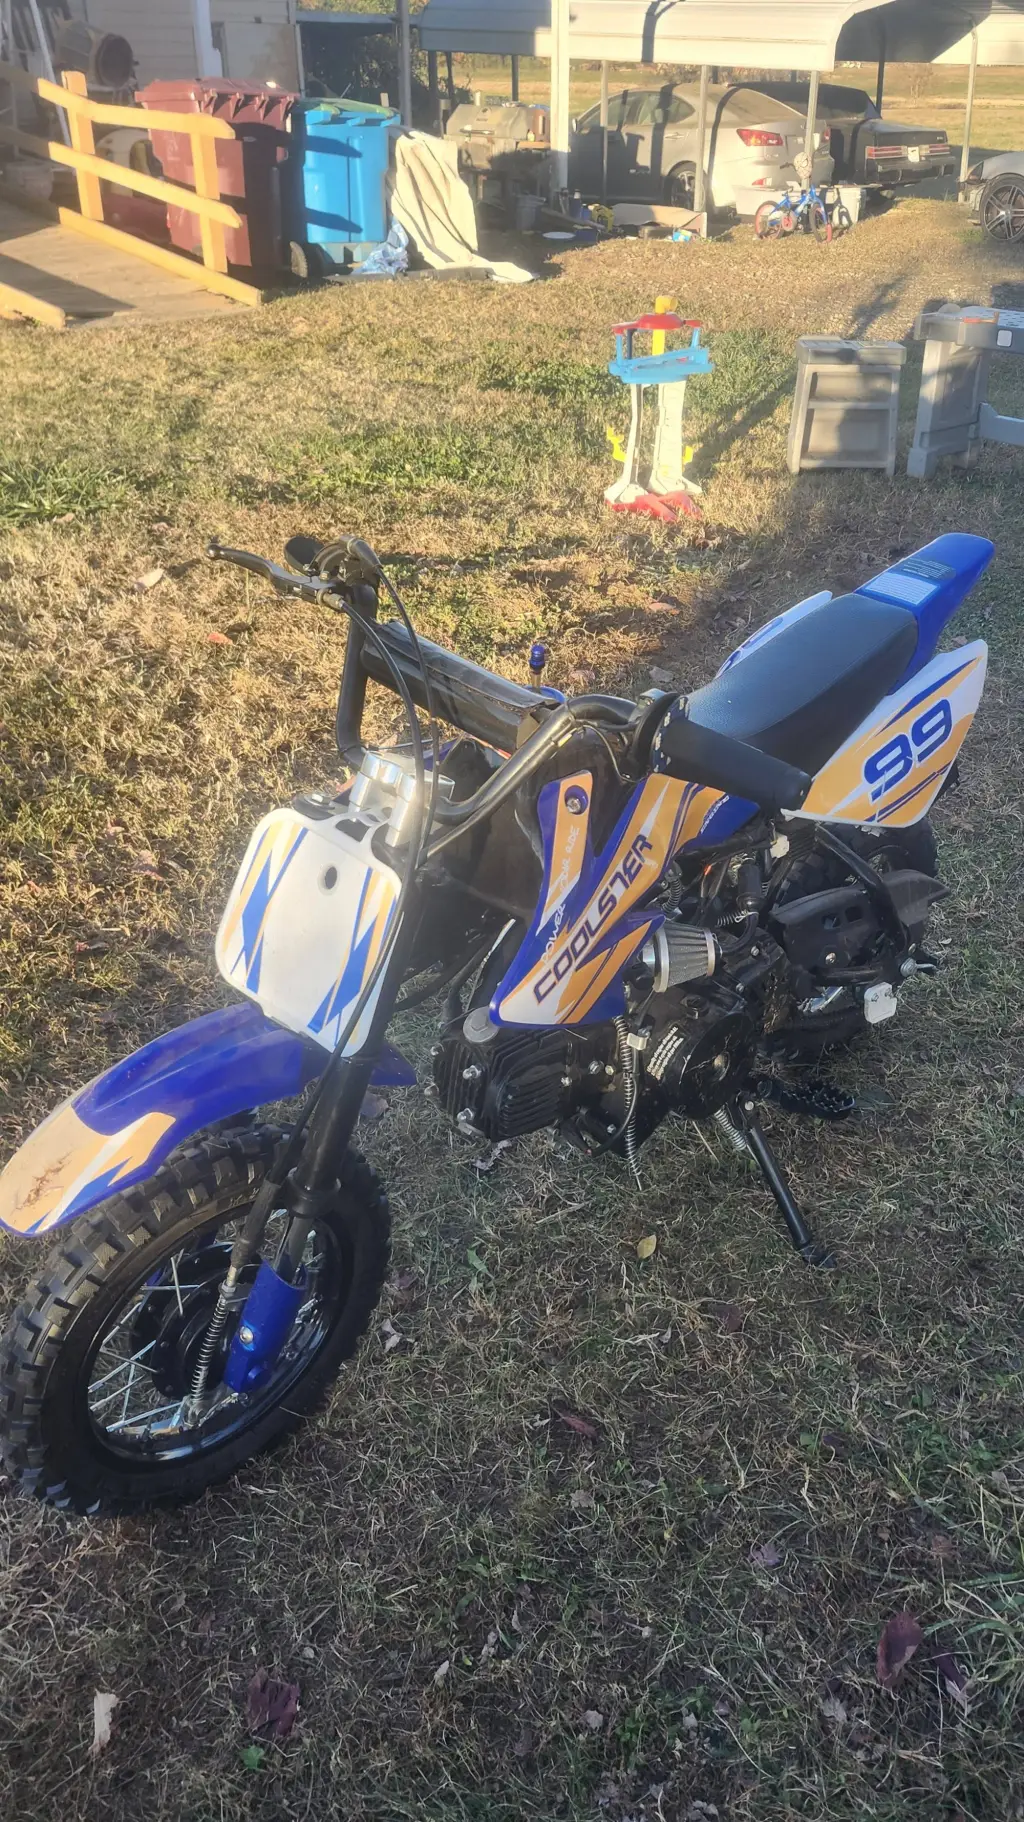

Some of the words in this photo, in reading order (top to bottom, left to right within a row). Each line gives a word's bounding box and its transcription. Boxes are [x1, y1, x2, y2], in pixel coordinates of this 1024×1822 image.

[862, 698, 953, 804] 99
[533, 833, 653, 1005] COOLSTER
[540, 903, 566, 964] POWER
[565, 825, 580, 854] RIDE
